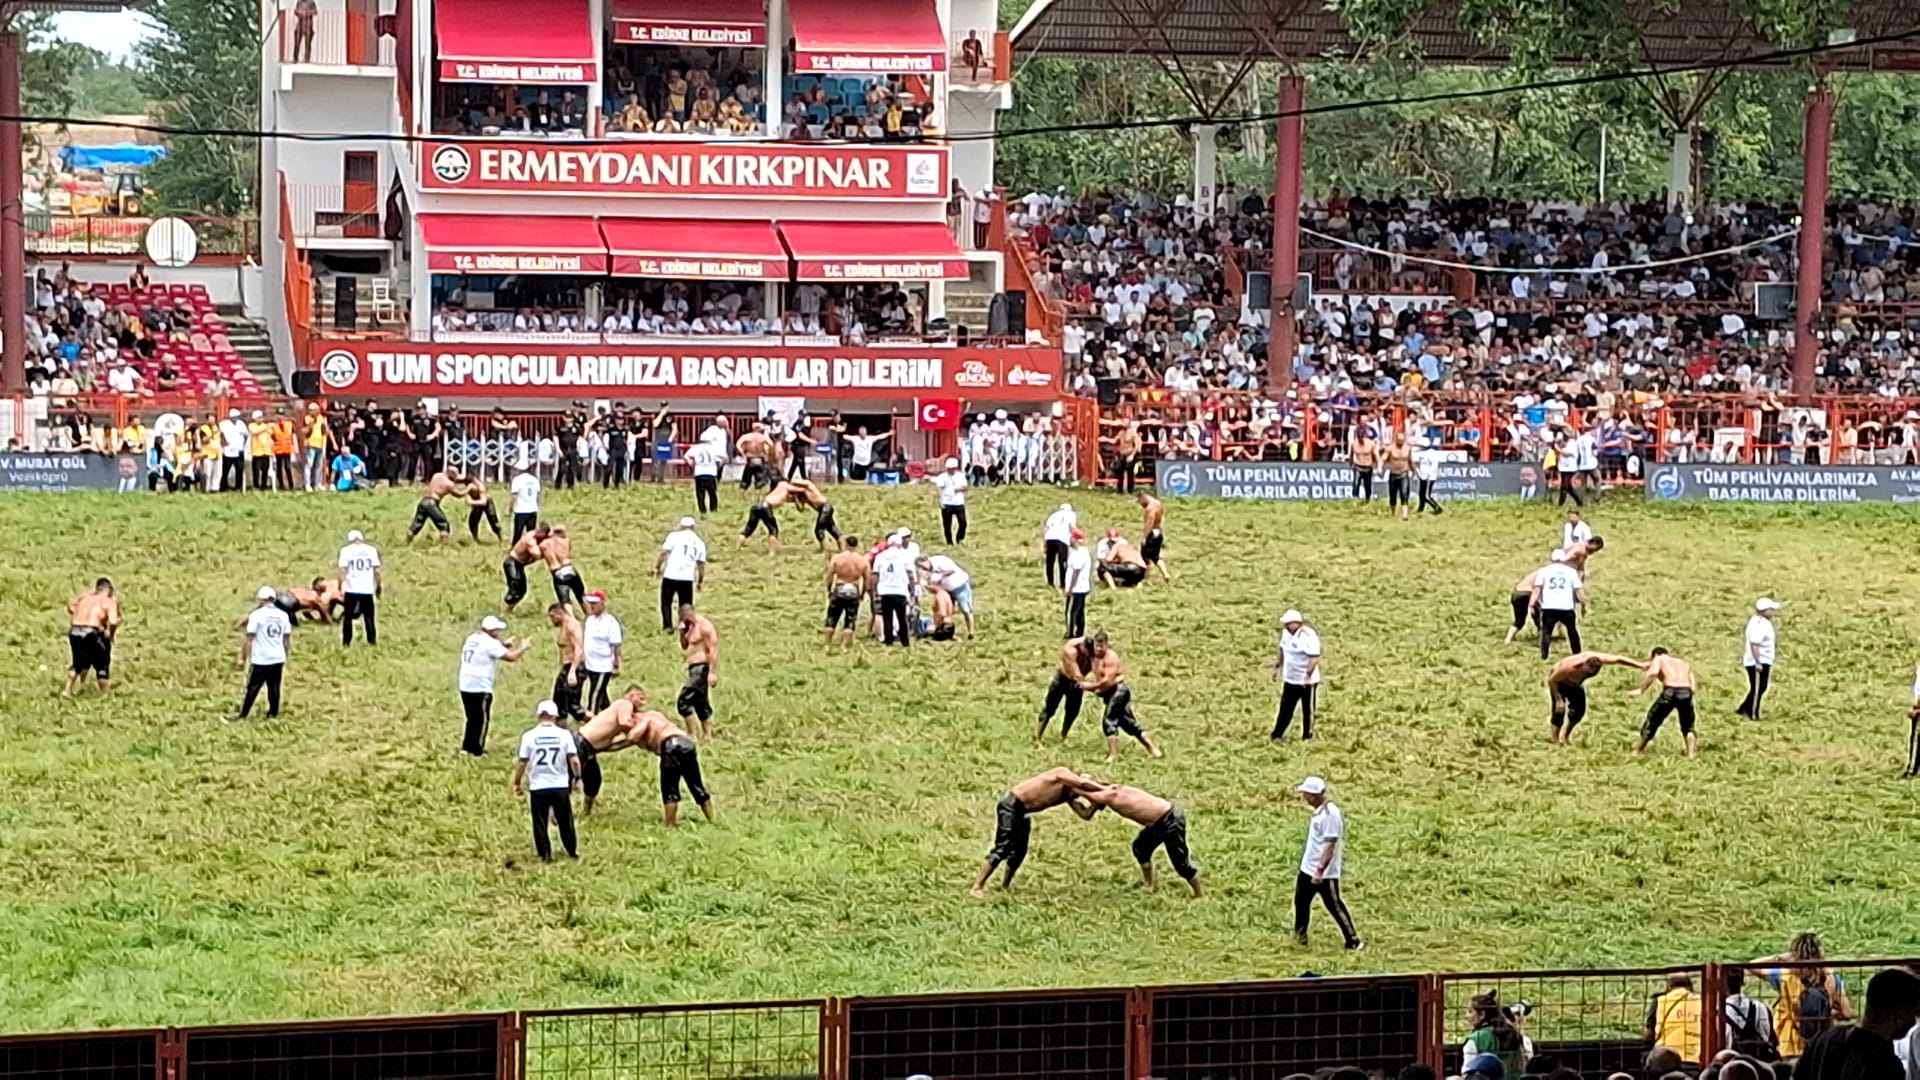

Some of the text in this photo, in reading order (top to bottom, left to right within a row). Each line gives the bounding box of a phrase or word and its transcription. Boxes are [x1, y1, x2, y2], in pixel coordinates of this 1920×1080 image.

[479, 148, 892, 188] ERMEYDANI KIRKPINAR
[436, 354, 677, 387] SPORCULARIMIZA
[681, 357, 829, 389] BAŞARILAR
[832, 358, 943, 388] DİLERİM
[0, 455, 87, 469] V. MURAT GÜL
[1205, 465, 1241, 481] TÜM
[1693, 468, 1878, 486] TÜM PEHLİVANLARIMIZA
[1549, 576, 1567, 590] 52
[535, 747, 561, 766] 27
